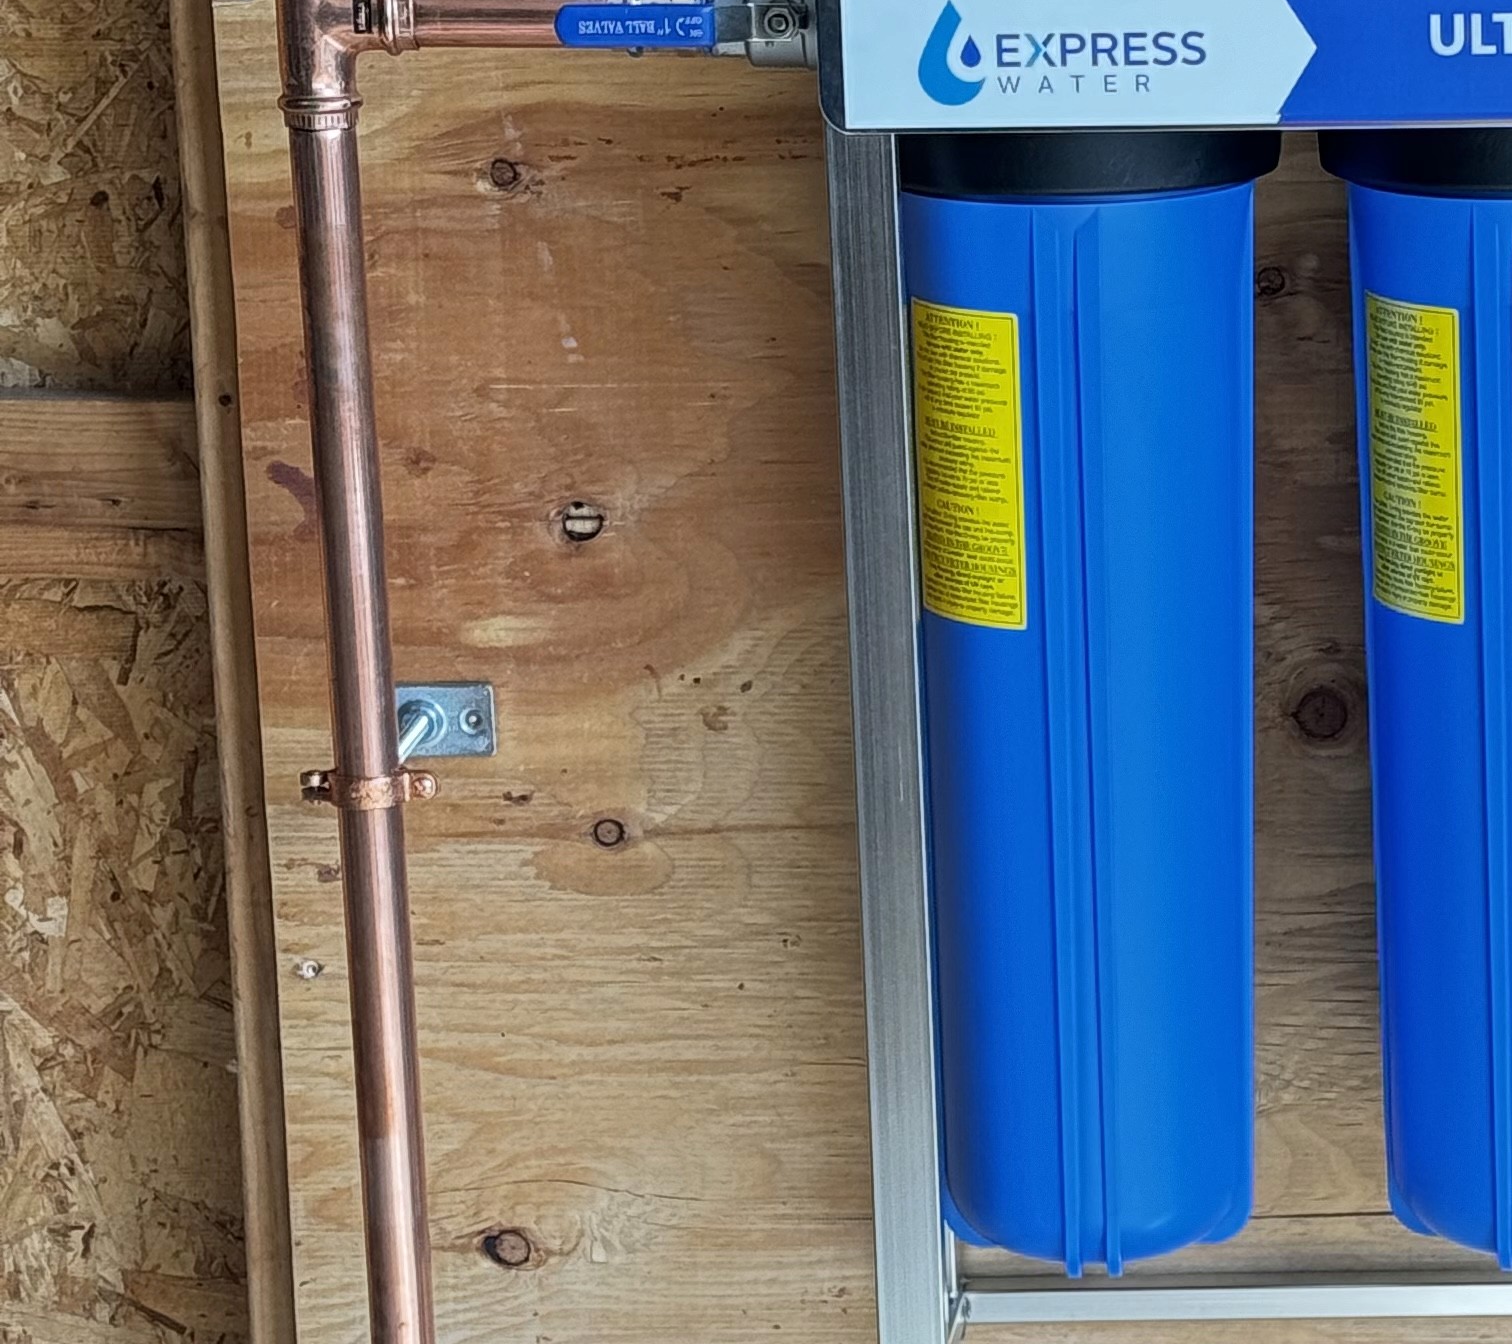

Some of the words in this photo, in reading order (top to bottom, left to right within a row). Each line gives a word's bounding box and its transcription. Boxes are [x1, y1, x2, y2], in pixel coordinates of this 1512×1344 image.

[578, 20, 624, 34] VALVES
[625, 20, 655, 34] BALL
[996, 31, 1207, 68] EXPRESS
[997, 74, 1150, 93] WATER
